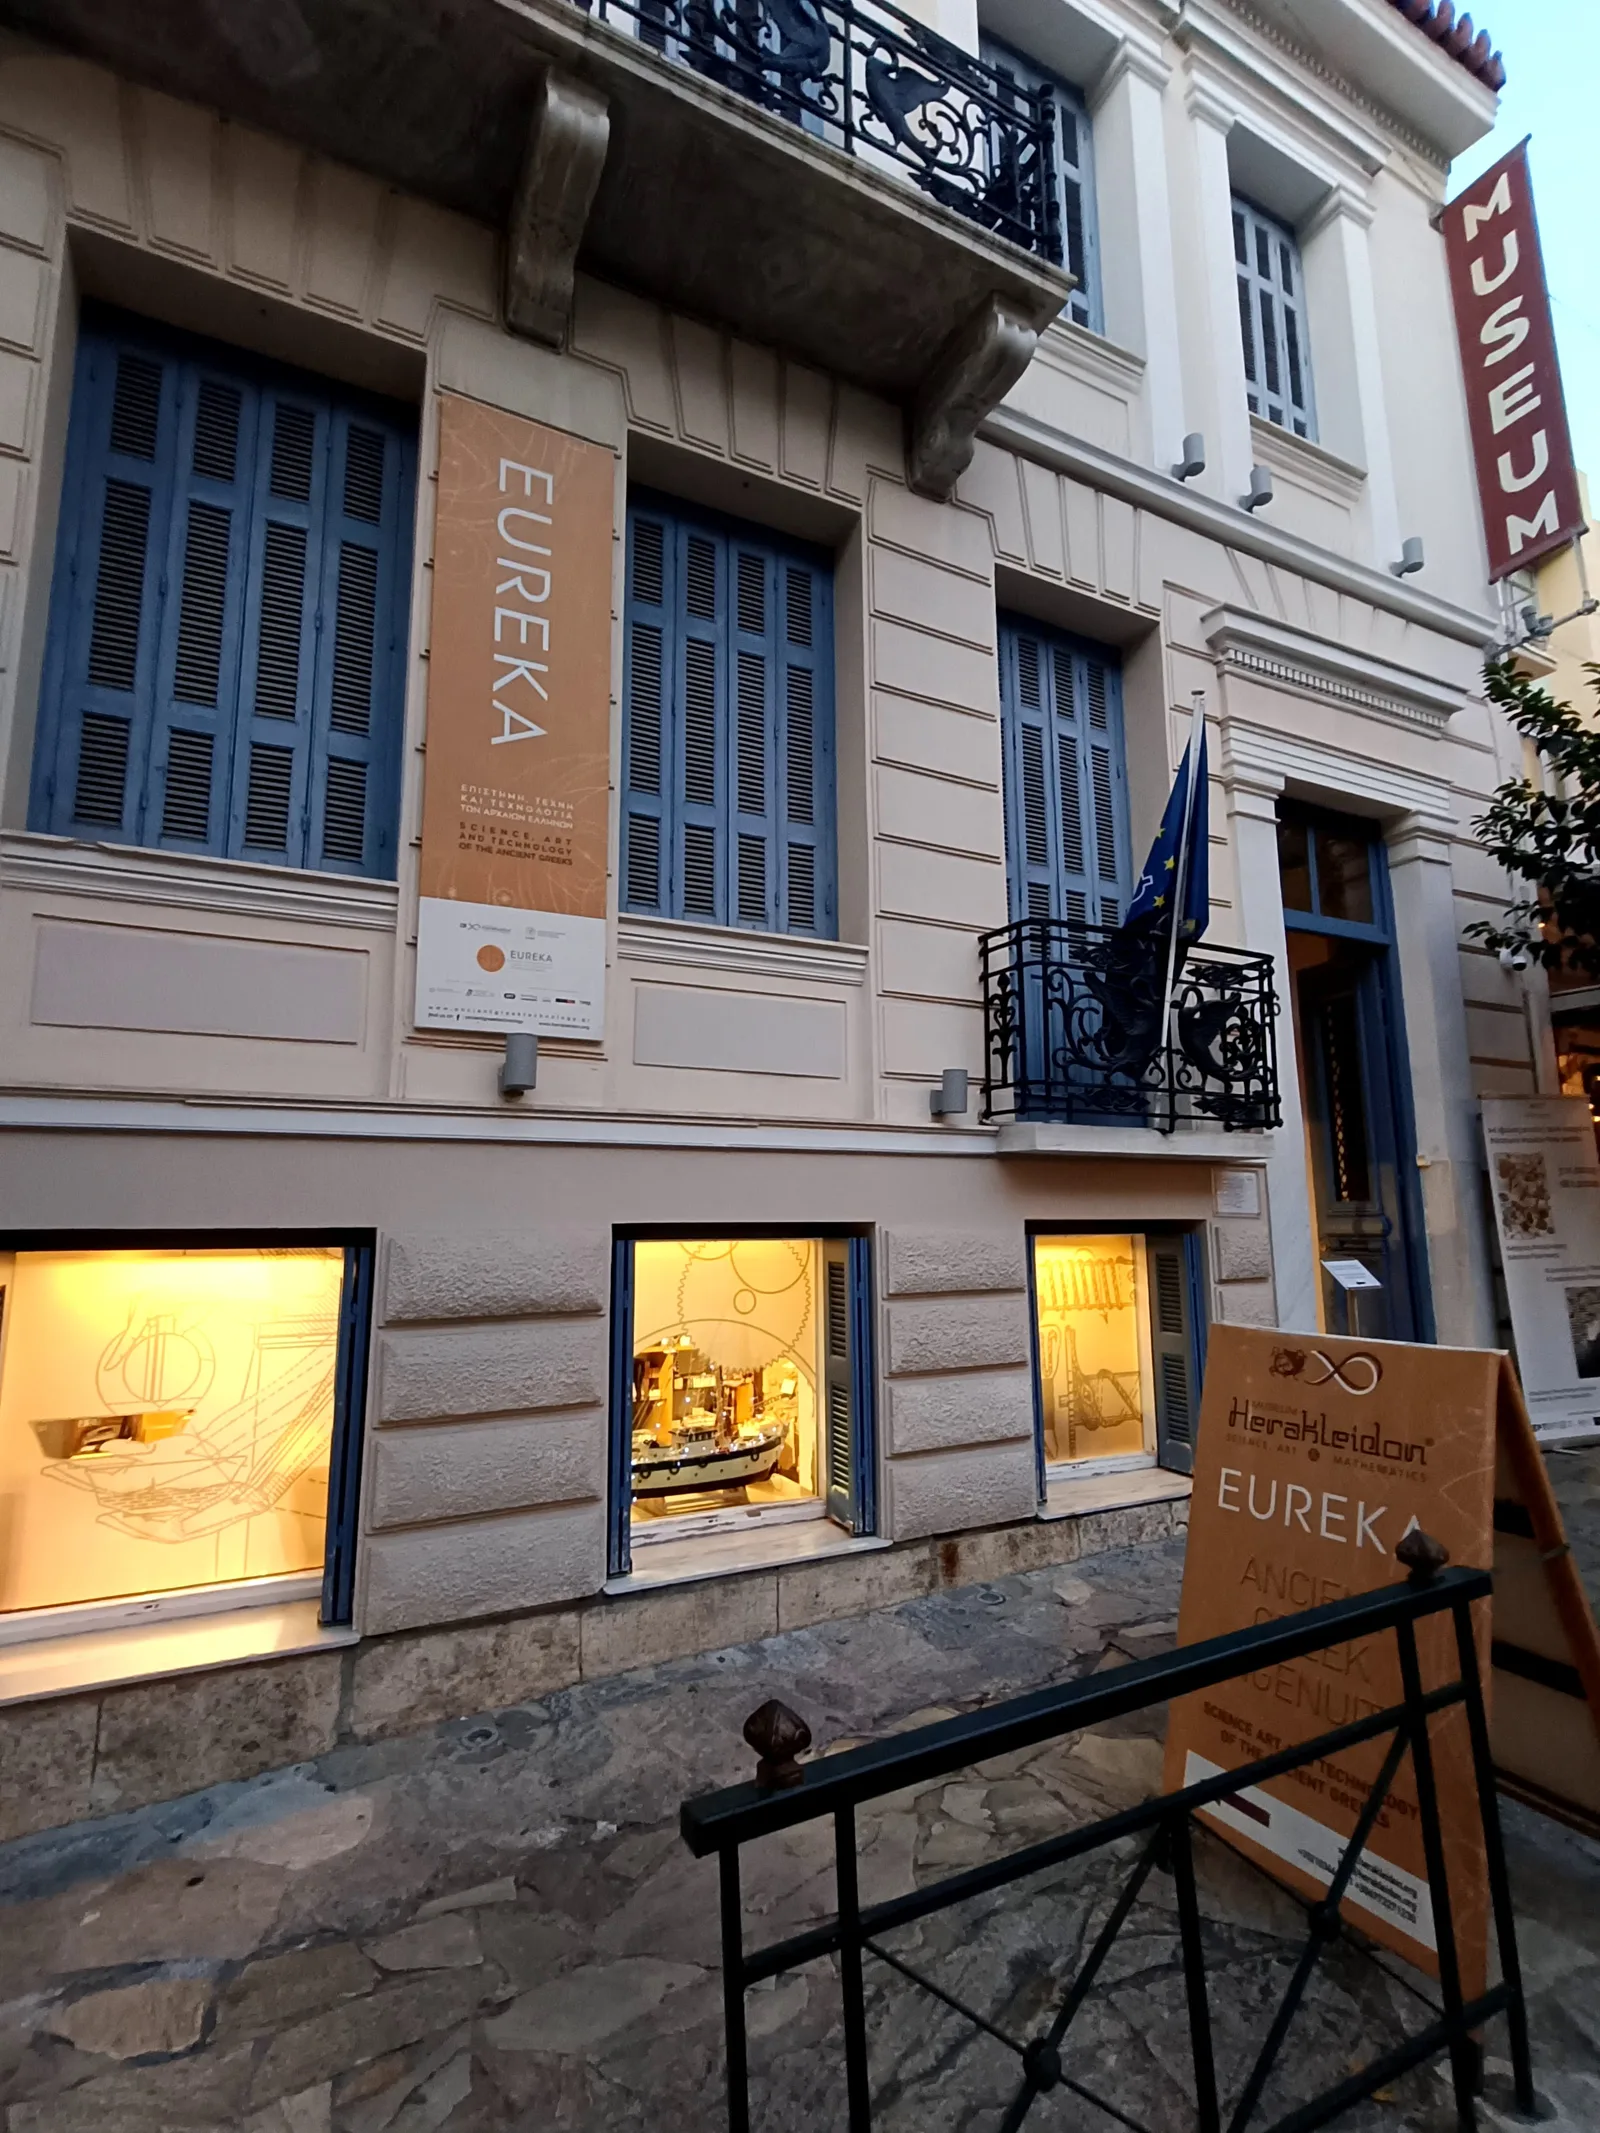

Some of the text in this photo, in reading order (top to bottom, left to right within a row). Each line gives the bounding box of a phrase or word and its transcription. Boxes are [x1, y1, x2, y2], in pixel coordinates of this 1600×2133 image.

[1462, 171, 1560, 555] MUSEUM
[491, 457, 554, 745] EUREKA
[460, 794, 483, 805] ΚΑΙ
[459, 831, 573, 856] AND TECHNOLOGY
[543, 836, 573, 846] ART
[458, 842, 573, 866] OF THE ANCIENT GREEKS
[510, 950, 553, 963] EUREKA
[1228, 1396, 1428, 1466] Herakleidon
[1240, 1557, 1356, 1608] ANCIE
[1203, 1701, 1253, 1737] SCIENCE
[1256, 1729, 1282, 1750] ART
[1220, 1730, 1237, 1744] OF
